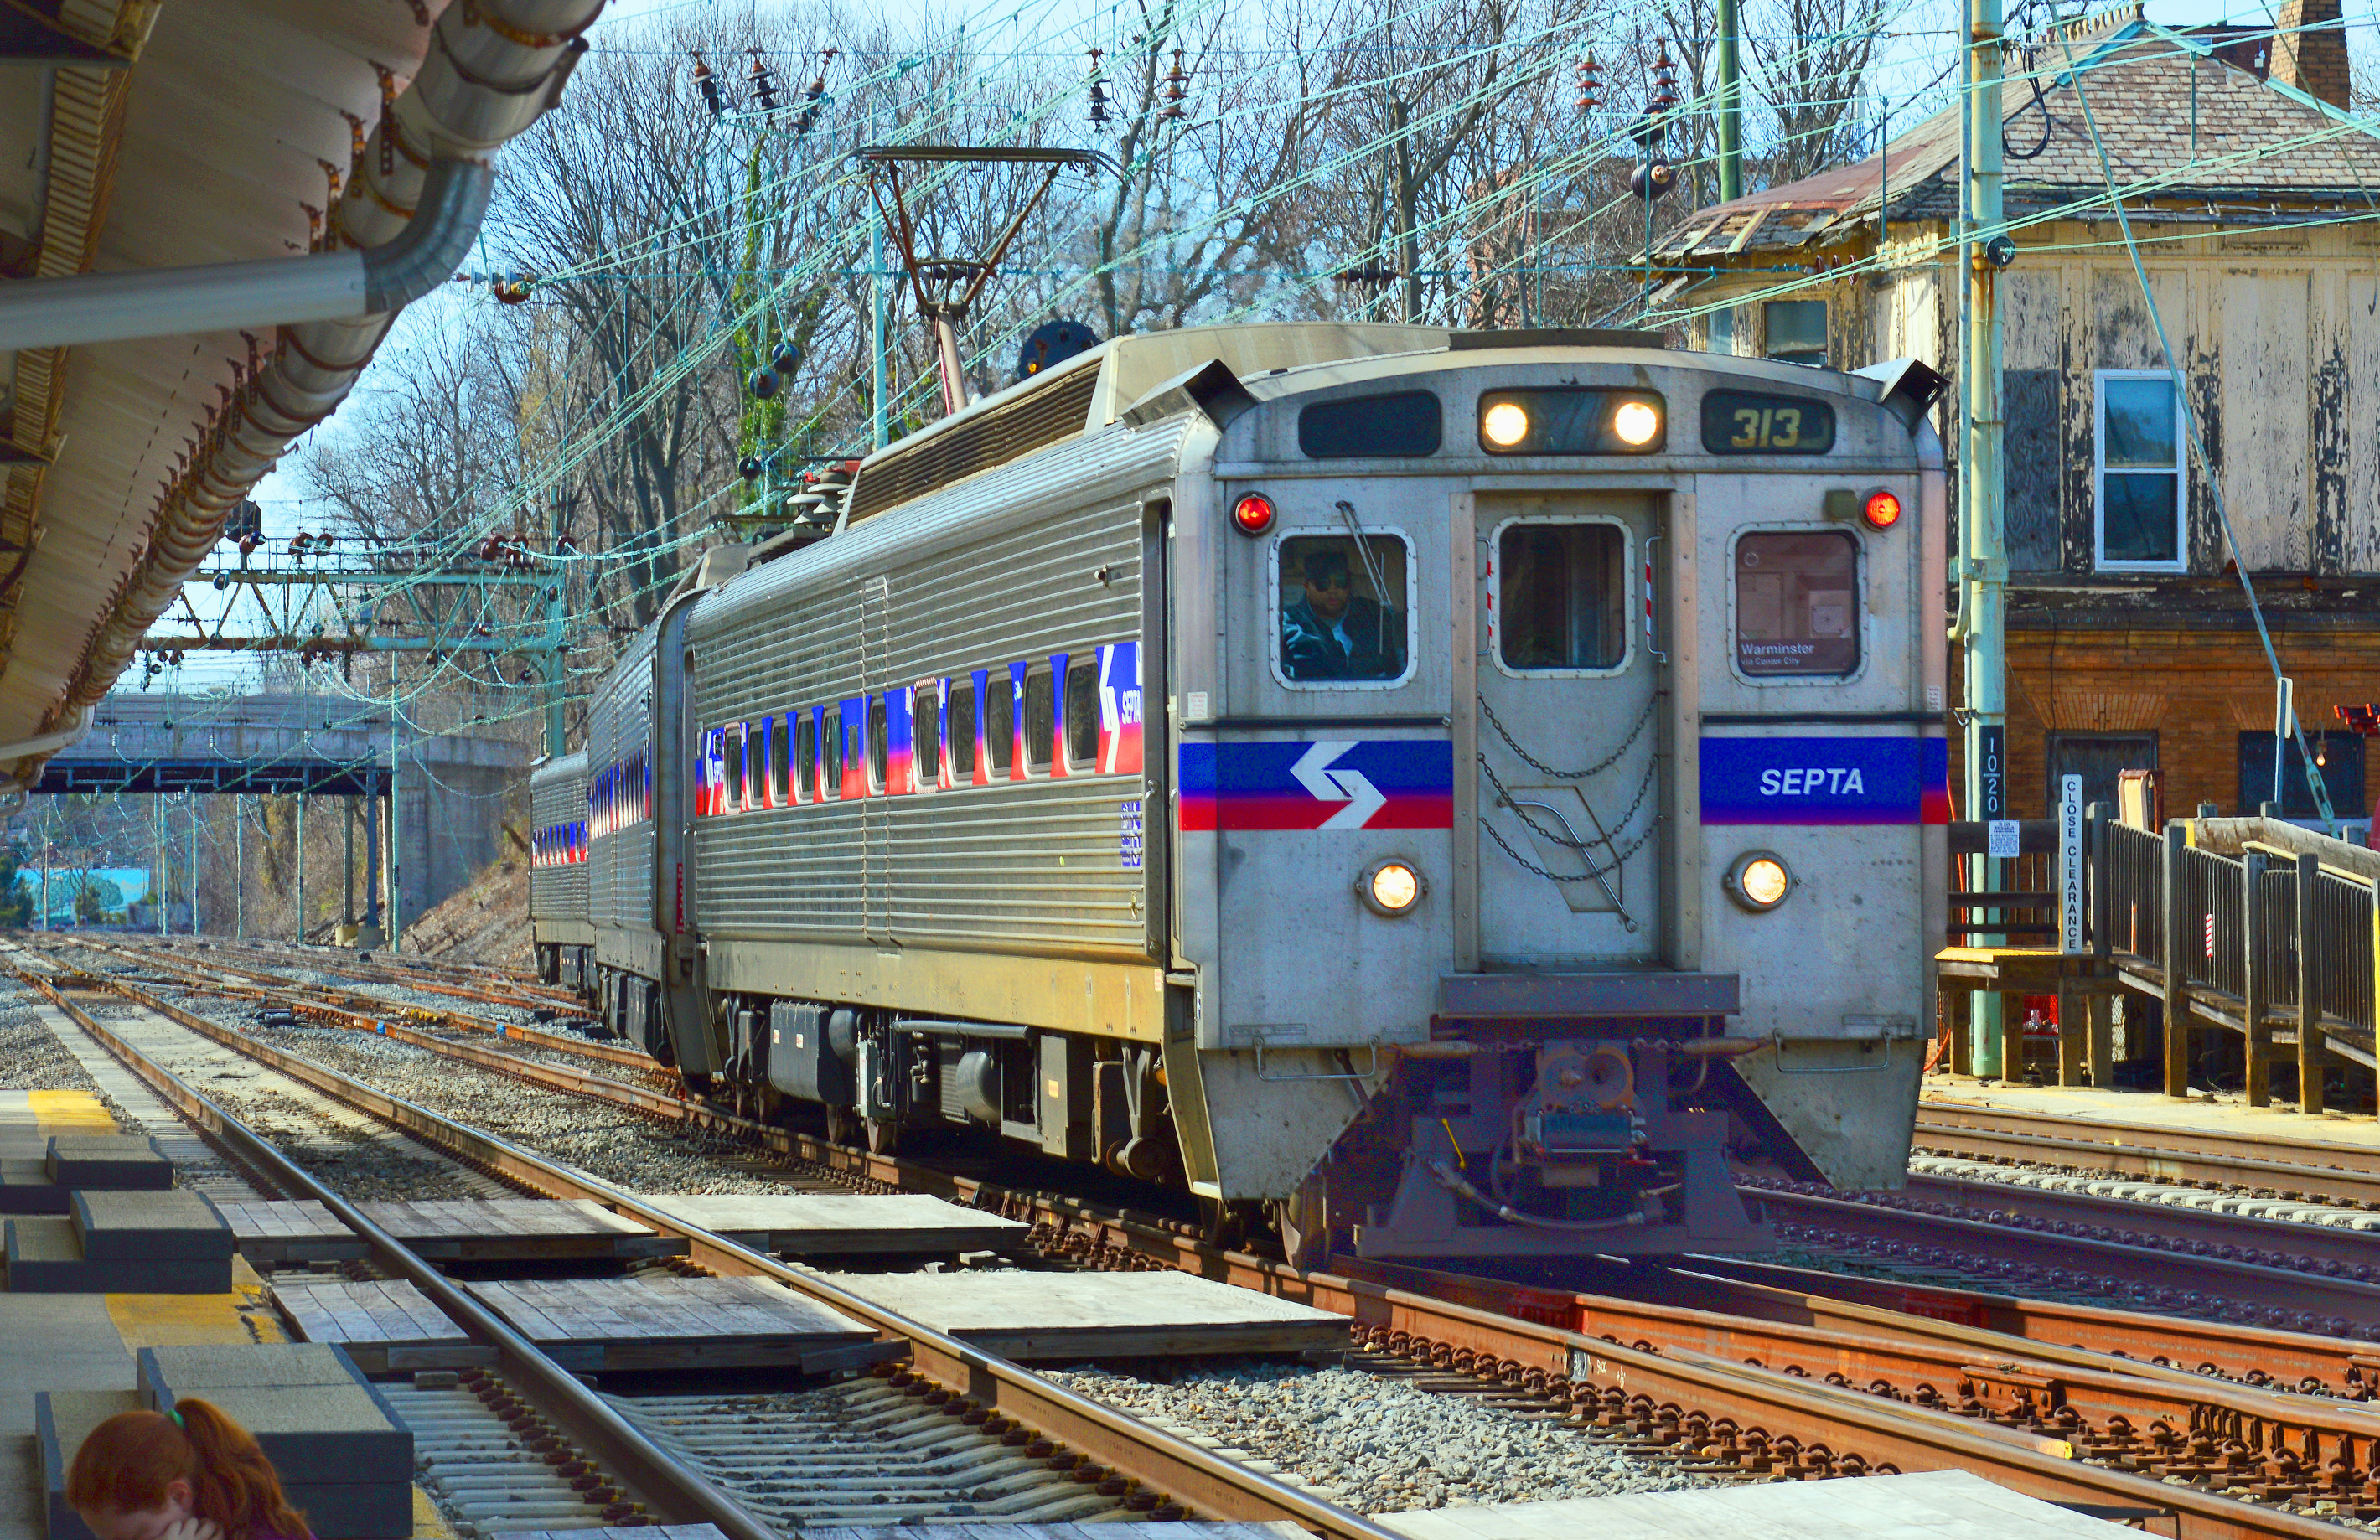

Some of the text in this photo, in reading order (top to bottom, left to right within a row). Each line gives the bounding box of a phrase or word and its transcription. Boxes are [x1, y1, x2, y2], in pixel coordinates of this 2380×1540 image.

[1731, 407, 1802, 447] 313
[1741, 643, 1815, 654] Warminster
[1755, 657, 1782, 665] Center
[1783, 656, 1800, 667] City
[1121, 689, 1141, 726] SEPTA
[1759, 767, 1865, 796] SEPTA
[2067, 781, 2077, 950] CLOSE CLEARANCE
